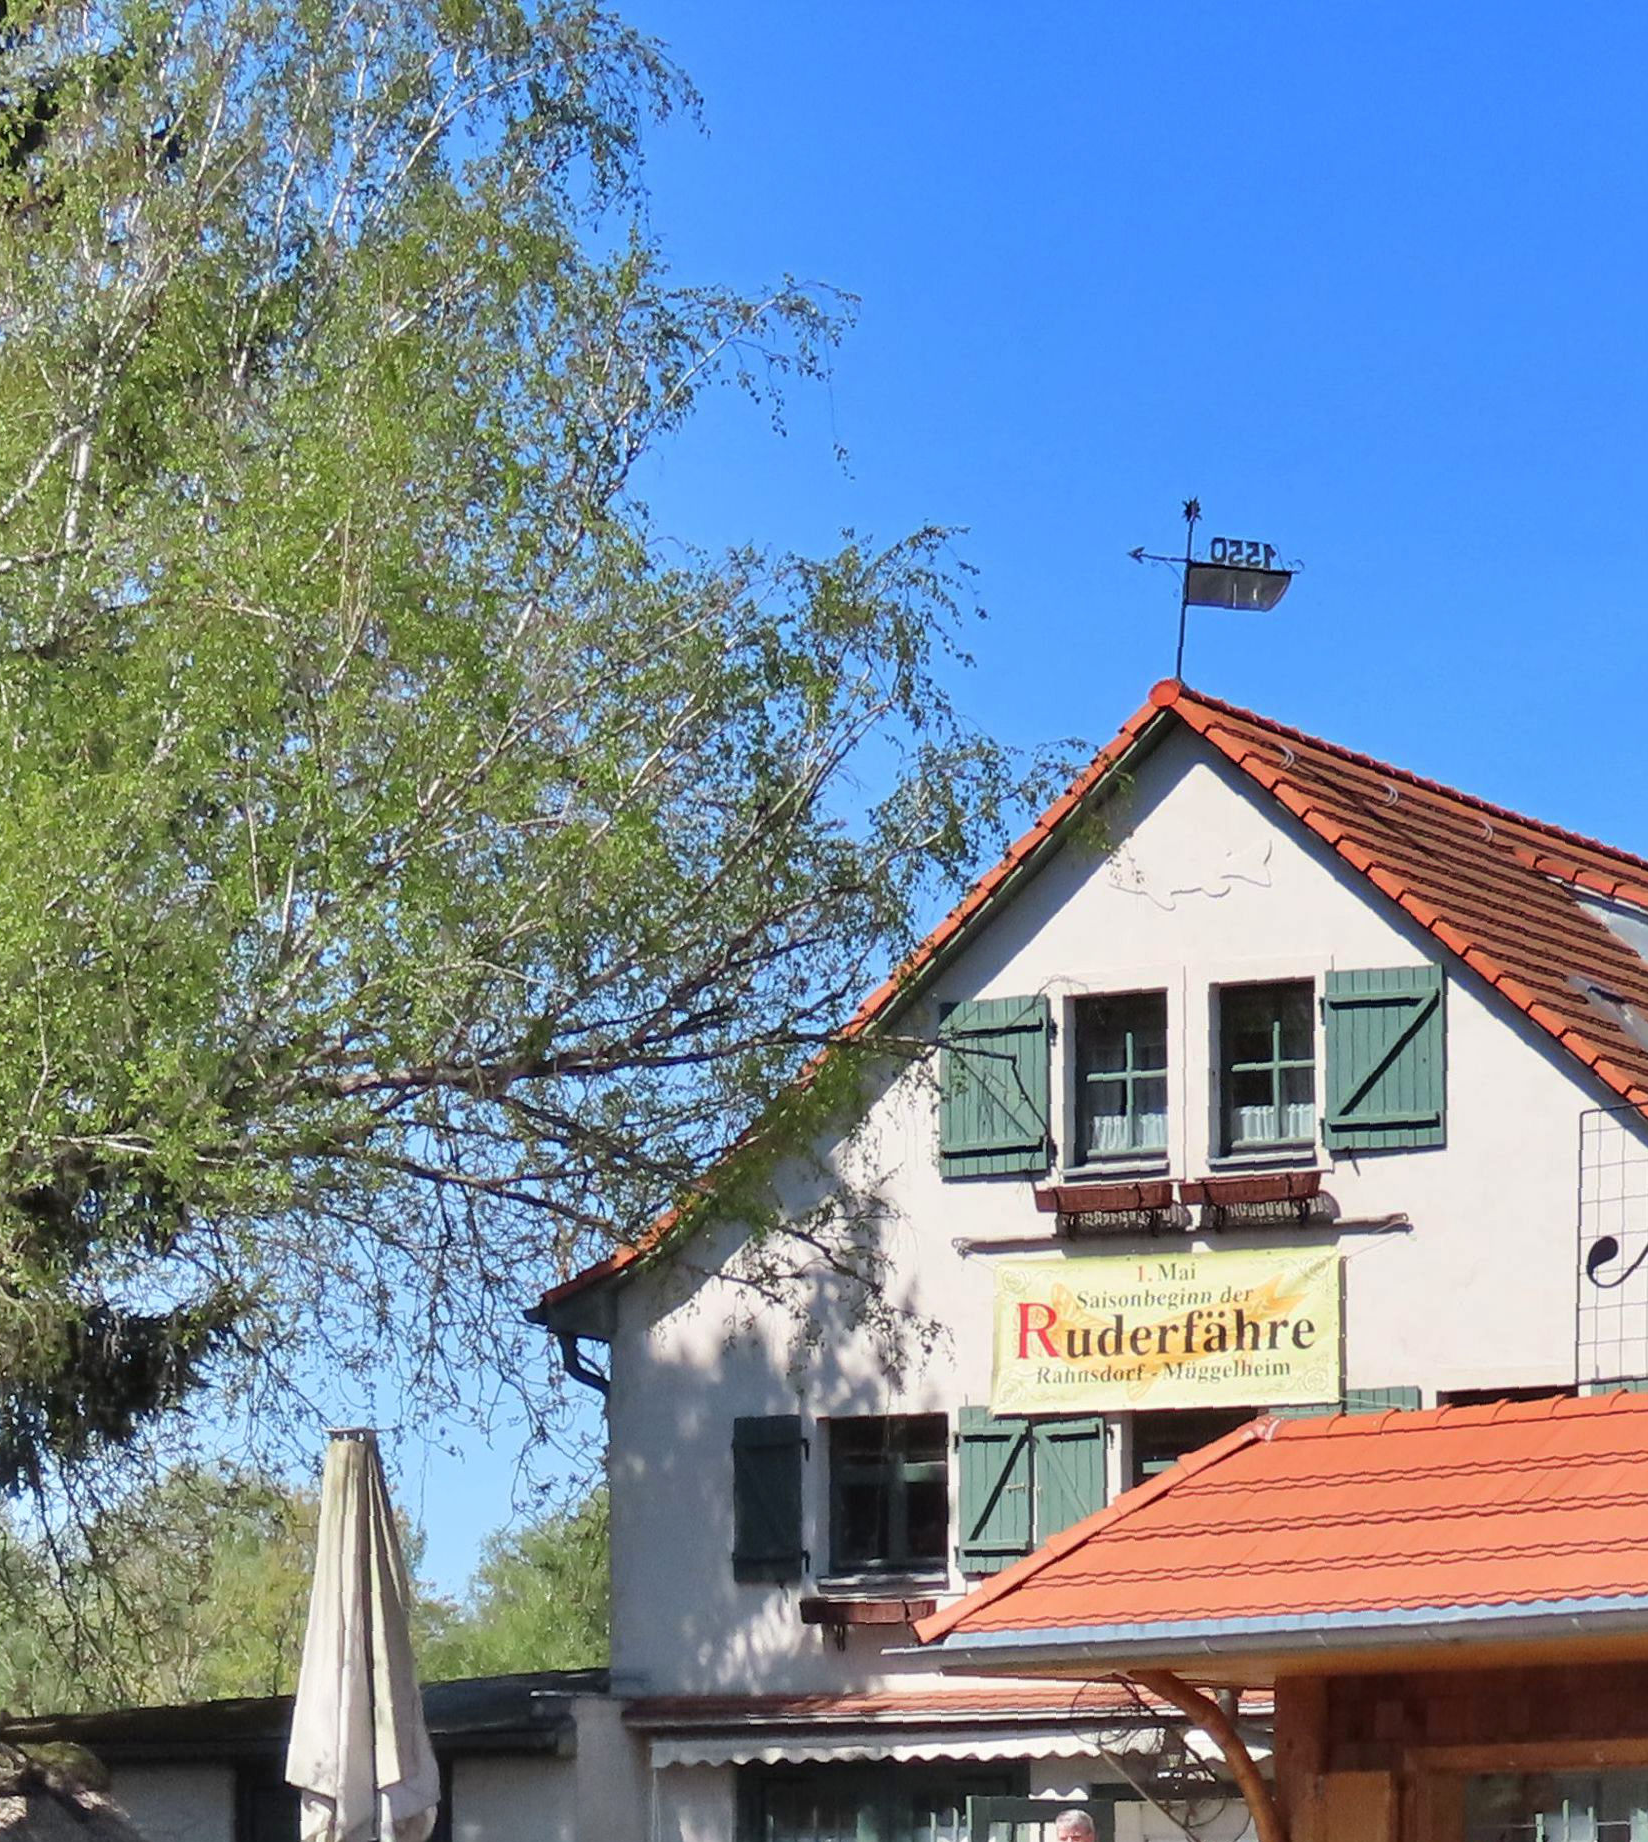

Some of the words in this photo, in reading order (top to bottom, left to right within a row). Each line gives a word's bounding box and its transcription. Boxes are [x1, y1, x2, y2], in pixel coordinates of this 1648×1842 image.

[1136, 1265, 1152, 1283] 1.
[1158, 1263, 1196, 1282] Mai
[1077, 1289, 1213, 1311] Saisonbeginn
[1220, 1286, 1253, 1304] der
[1017, 1302, 1315, 1360] Ruderfähre
[1037, 1364, 1146, 1385] Rahnsdorf
[1163, 1360, 1291, 1385] Müggelheim
